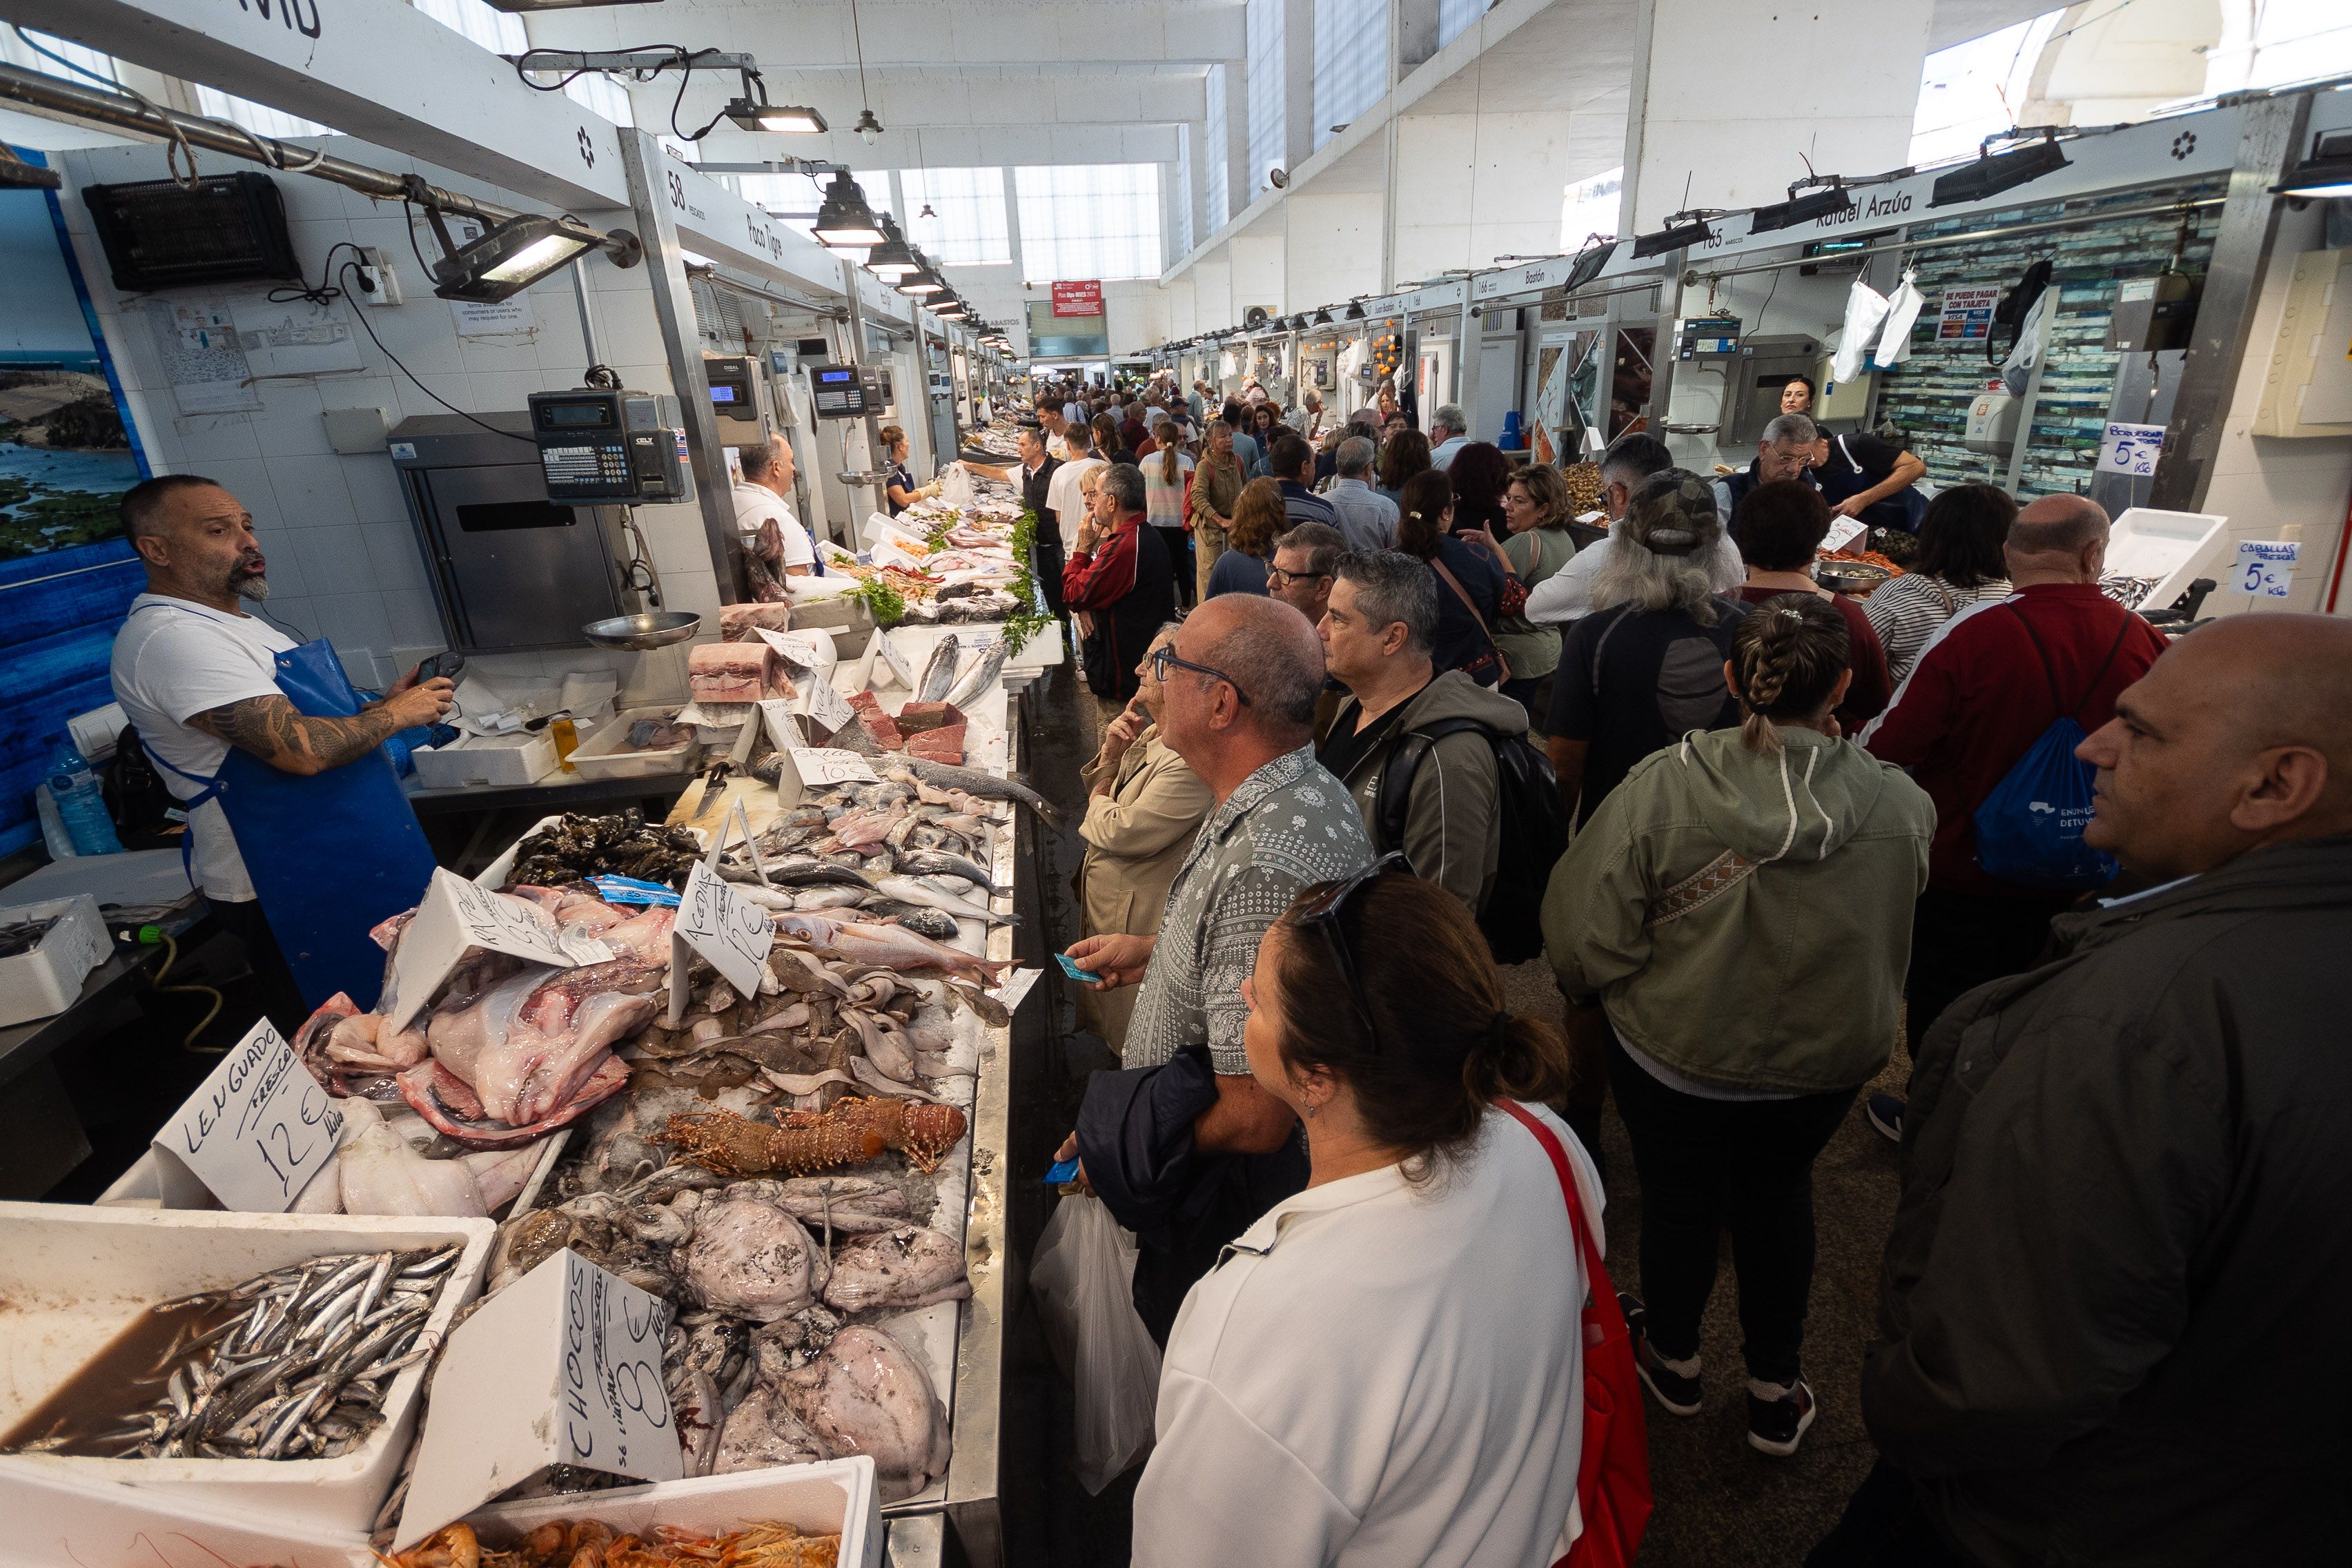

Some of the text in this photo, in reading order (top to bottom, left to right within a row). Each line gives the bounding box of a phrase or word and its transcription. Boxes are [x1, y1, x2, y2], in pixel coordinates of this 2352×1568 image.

[667, 170, 685, 211] 58
[1865, 190, 1912, 219] Arzúa
[746, 213, 783, 275] Paco Tigre
[1478, 280, 1487, 294] 166
[1525, 268, 1545, 284] Bastón
[1954, 291, 1975, 300] PUEDE
[1975, 290, 1997, 298] PAGAR
[1948, 300, 1990, 309] CON TARJETA
[2115, 441, 2147, 465] 5 €
[2240, 543, 2295, 554] CABALLAS
[2244, 562, 2275, 591] 5 €
[725, 906, 765, 976] 12 €
[184, 1028, 276, 1154] LENGUADO
[256, 1086, 328, 1197] 12 €
[566, 1259, 593, 1458] CHOCOS
[616, 1294, 667, 1429] 8 €
[618, 1443, 627, 1468] SE
